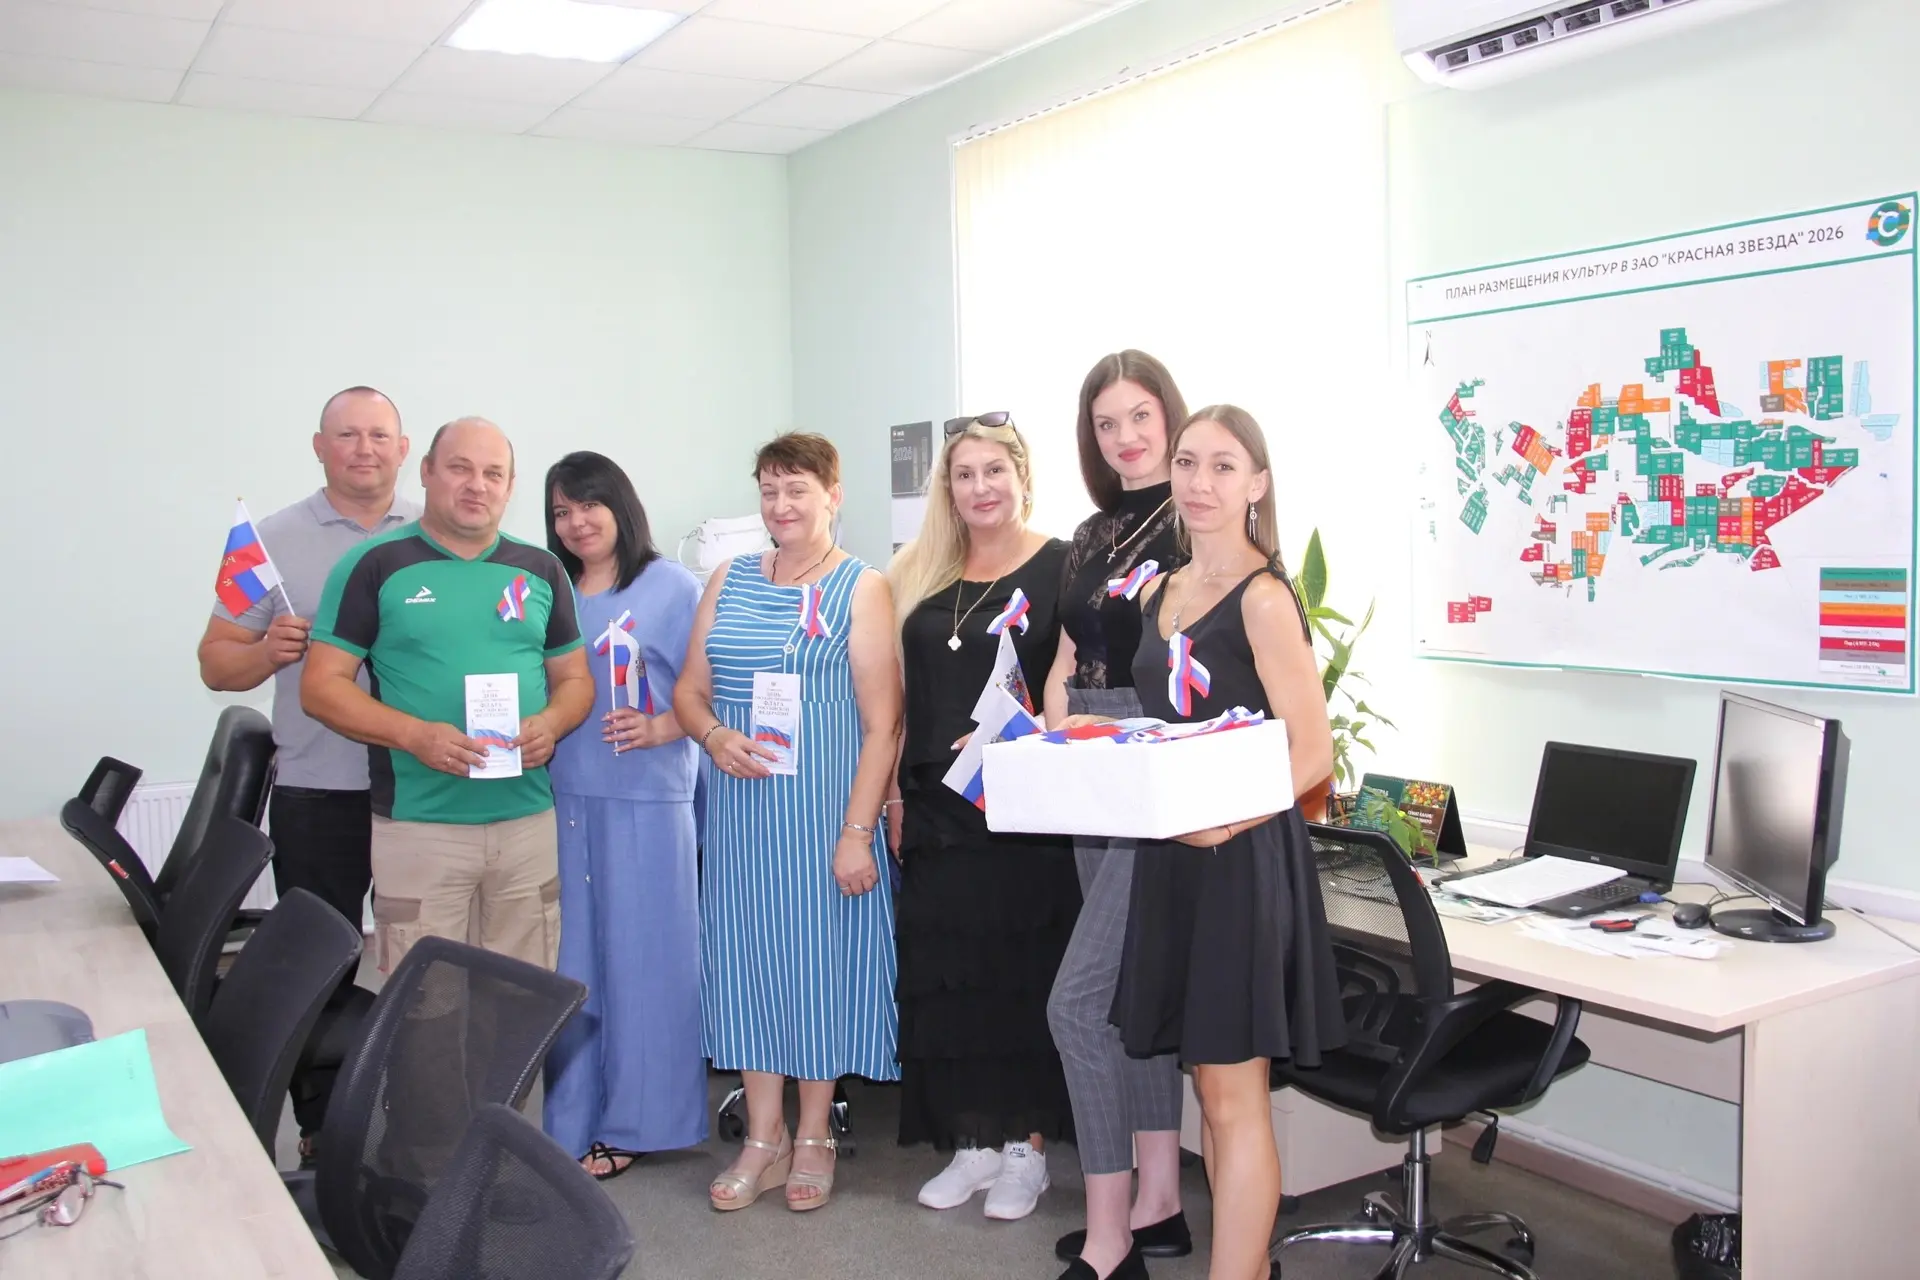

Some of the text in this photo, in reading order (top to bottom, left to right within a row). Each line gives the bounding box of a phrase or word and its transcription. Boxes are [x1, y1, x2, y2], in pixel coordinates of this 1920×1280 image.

[1445, 225, 1844, 300] ПЛАН РАЗМЕЩЕНИЯ КУЛЬТУР В ЗАО "КРАСНАЯ ЗВЕЗДА" 2026
